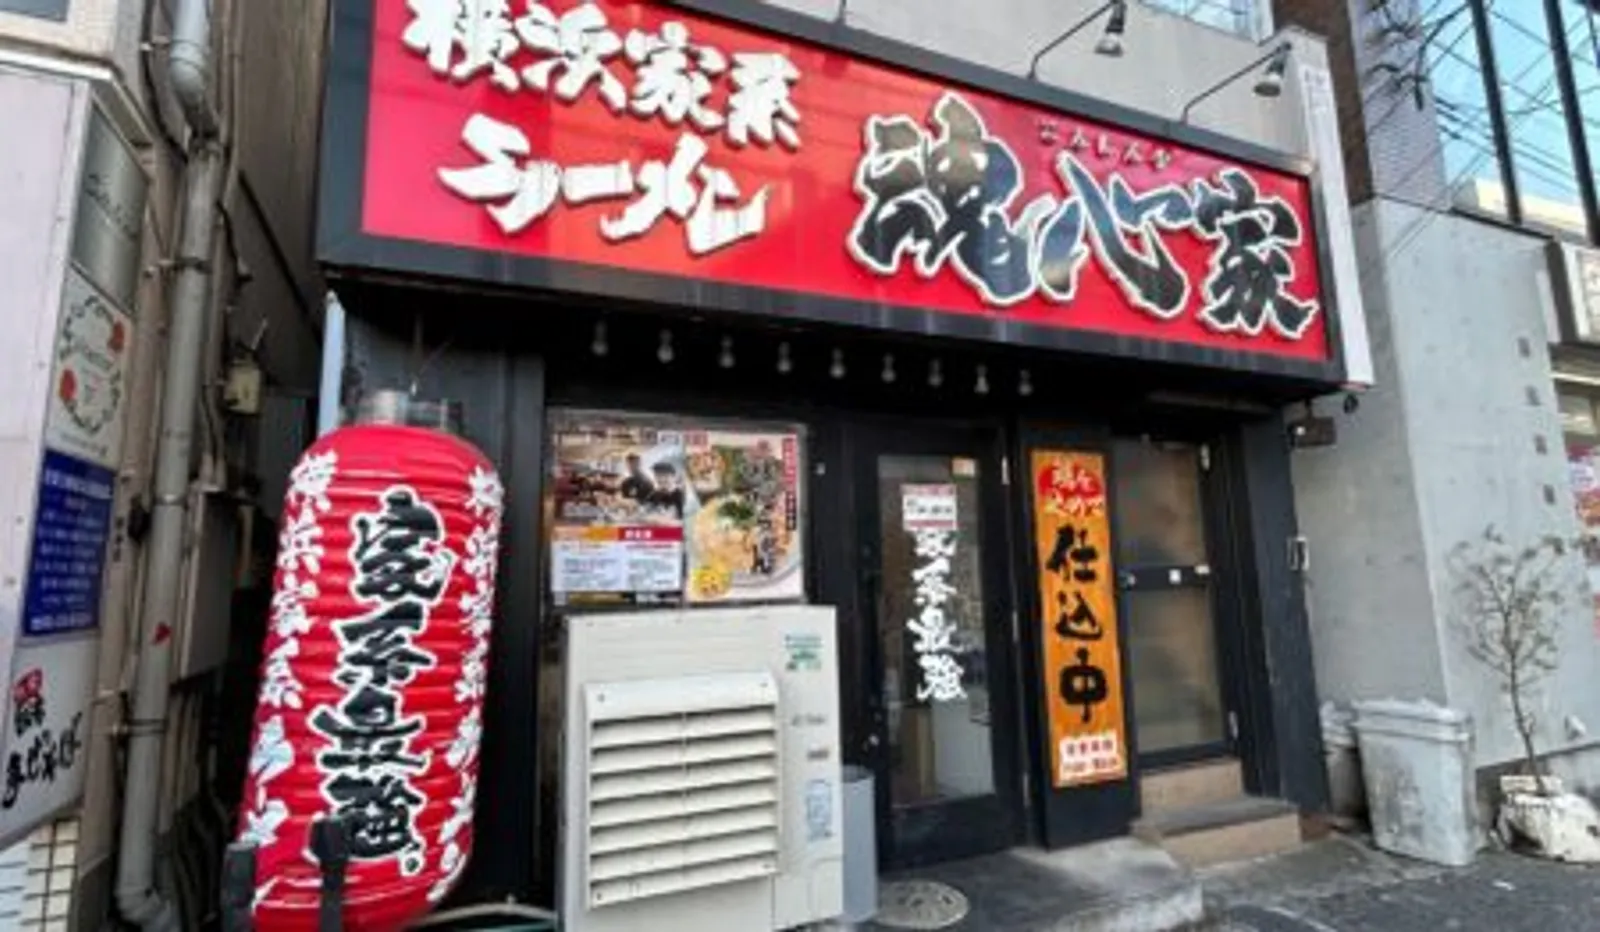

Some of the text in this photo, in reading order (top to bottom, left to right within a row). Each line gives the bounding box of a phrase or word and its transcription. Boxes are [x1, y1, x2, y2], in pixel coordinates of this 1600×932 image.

[402, 0, 800, 150] 横浜家系
[436, 112, 771, 256] ラーメン
[847, 91, 1319, 338] 魂心家
[1045, 523, 1109, 724] 仕込中
